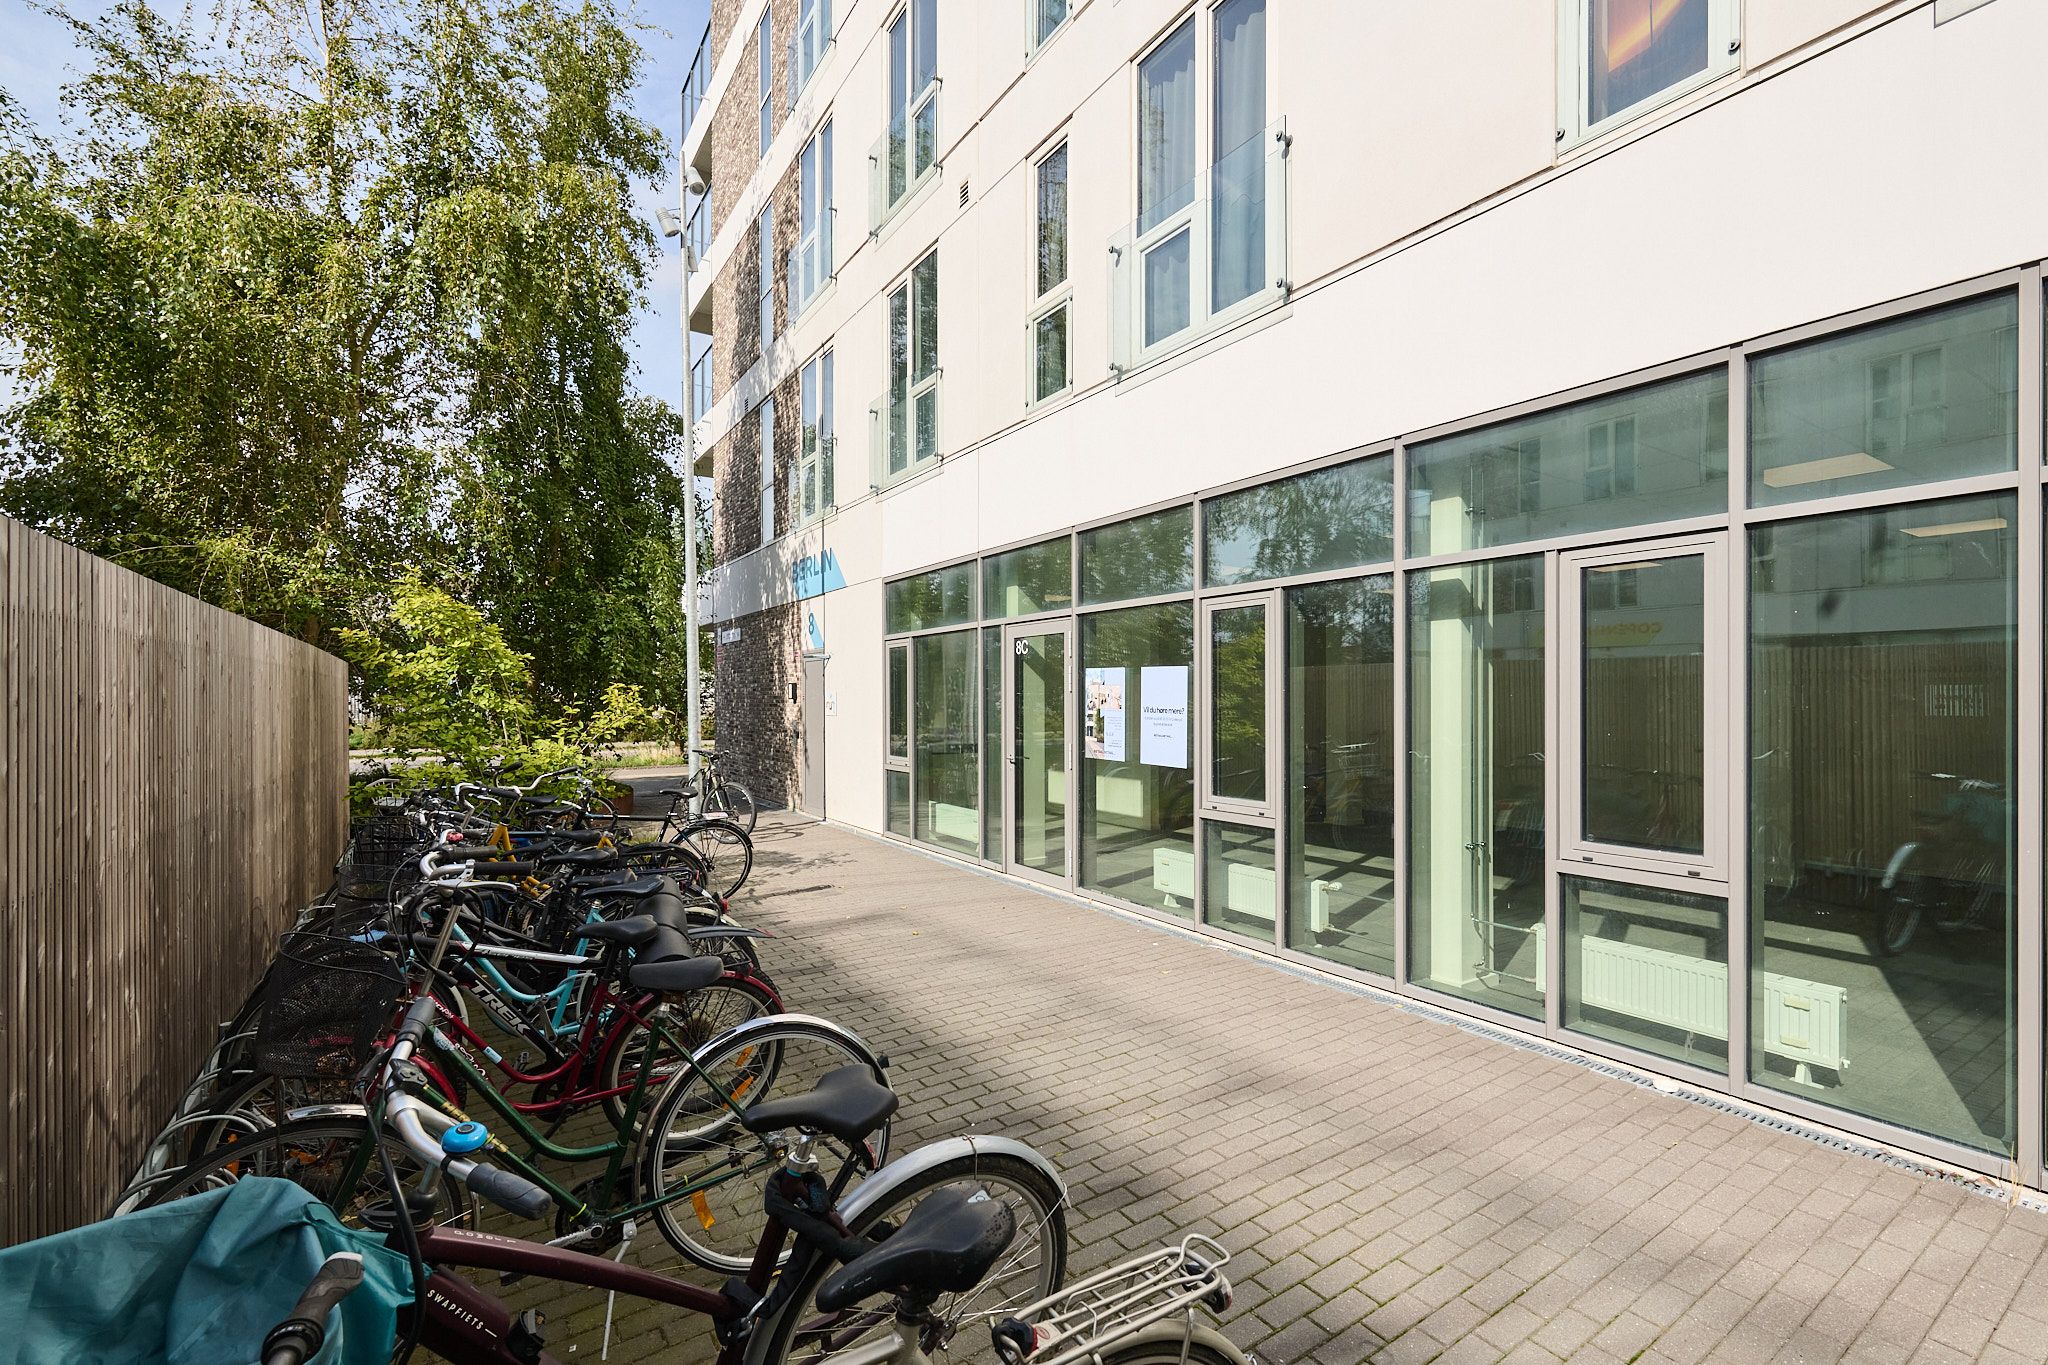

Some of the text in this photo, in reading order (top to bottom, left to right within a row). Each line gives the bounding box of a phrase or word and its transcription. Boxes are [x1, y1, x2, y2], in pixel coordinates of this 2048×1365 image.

[793, 547, 832, 584] BERLIN
[808, 612, 815, 636] 8
[1015, 639, 1029, 655] 8C
[470, 979, 531, 1035] TREK
[427, 1289, 484, 1330] SWAPFIETS
